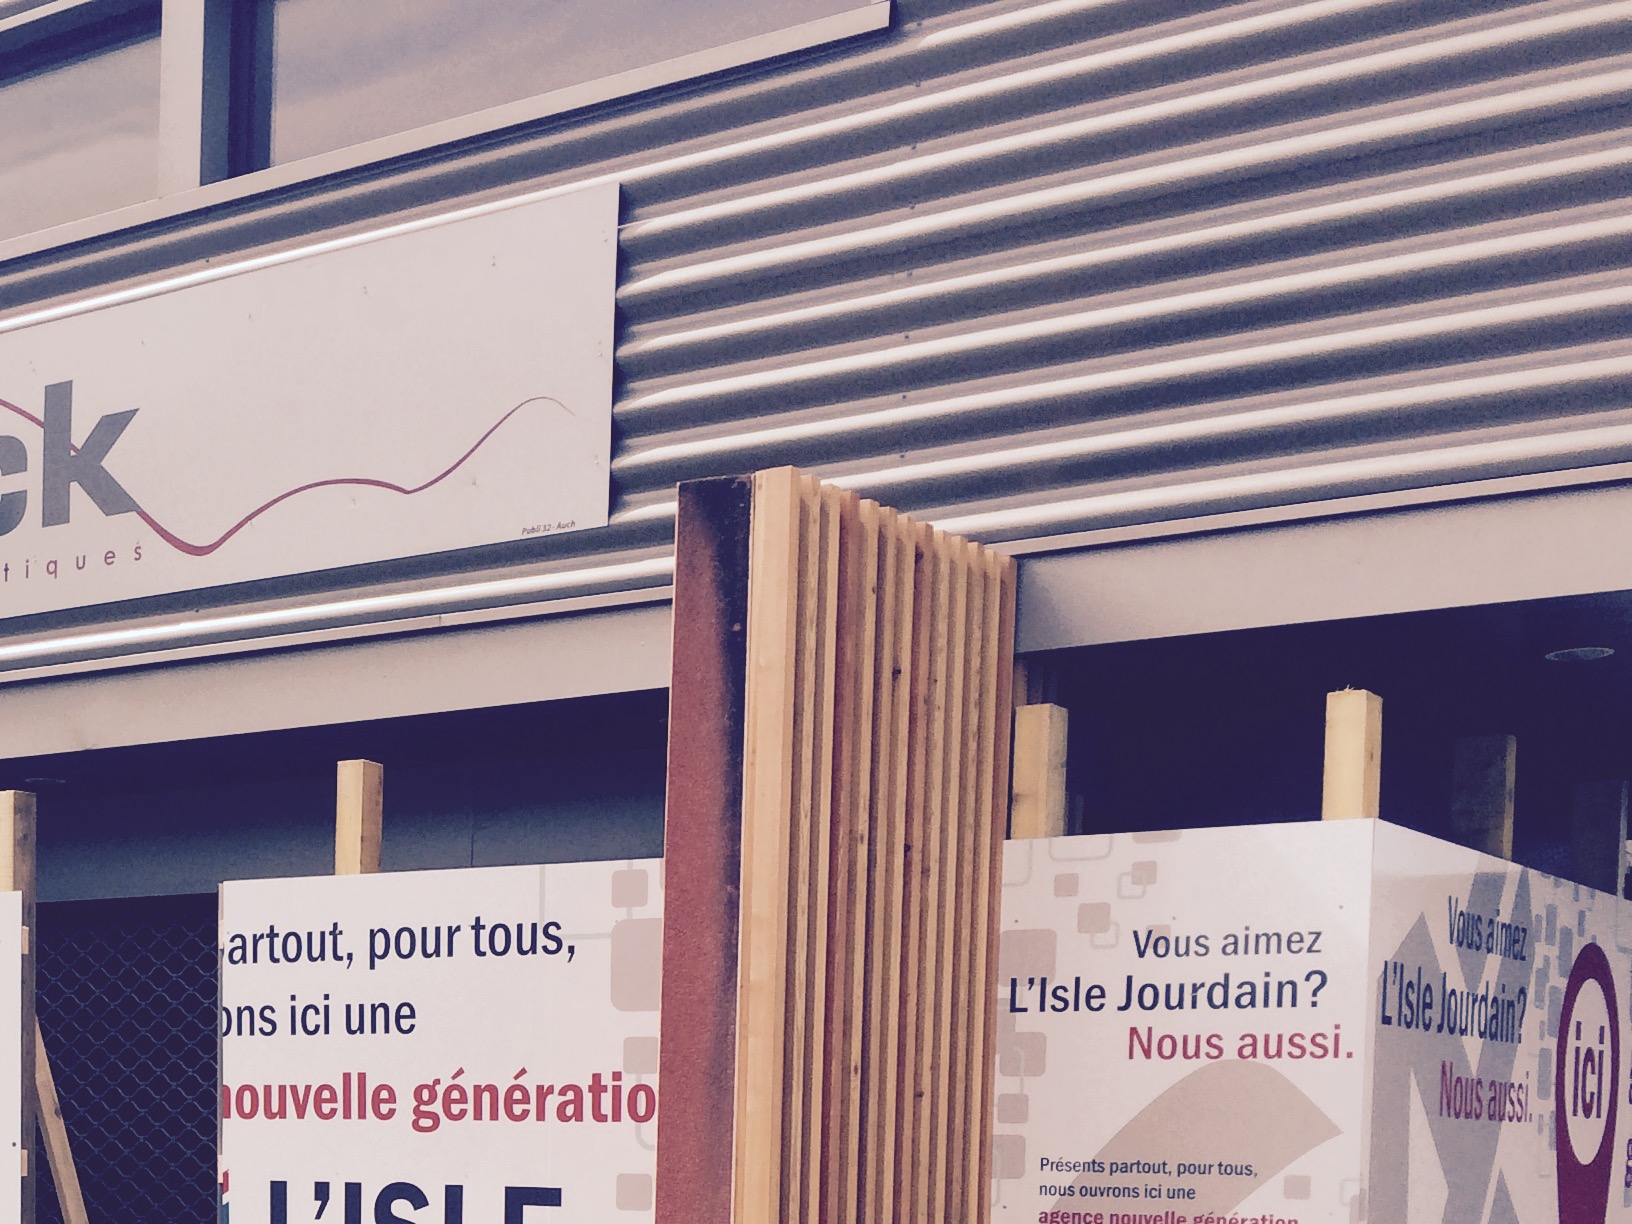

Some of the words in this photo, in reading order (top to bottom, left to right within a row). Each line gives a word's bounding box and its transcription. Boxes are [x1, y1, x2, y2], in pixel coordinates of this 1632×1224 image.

[221, 922, 354, 970] artout,
[369, 924, 462, 970] pour
[471, 916, 575, 963] tous,
[1133, 929, 1210, 958] Vous
[1222, 926, 1323, 956] aimez
[1448, 895, 1483, 952] Vous
[1486, 908, 1527, 961] aimez
[1117, 969, 1328, 1011] Jourdain?
[1437, 971, 1527, 1044] Jourdain?
[290, 993, 330, 1035] ici
[345, 1001, 416, 1035] une
[1128, 1026, 1224, 1060] Nous
[1237, 1024, 1354, 1060] aussi.
[1572, 1020, 1605, 1120] ici
[1439, 1060, 1483, 1121] Nous
[1487, 1071, 1532, 1123] aussi.
[1040, 1156, 1105, 1173] Présents
[1109, 1159, 1172, 1177] partout,
[1177, 1162, 1215, 1177] pour
[1217, 1160, 1258, 1178] tous,
[1039, 1183, 1075, 1197] nous
[1079, 1184, 1140, 1199] ouvrons
[1144, 1183, 1162, 1199] ici
[1167, 1186, 1196, 1200] une
